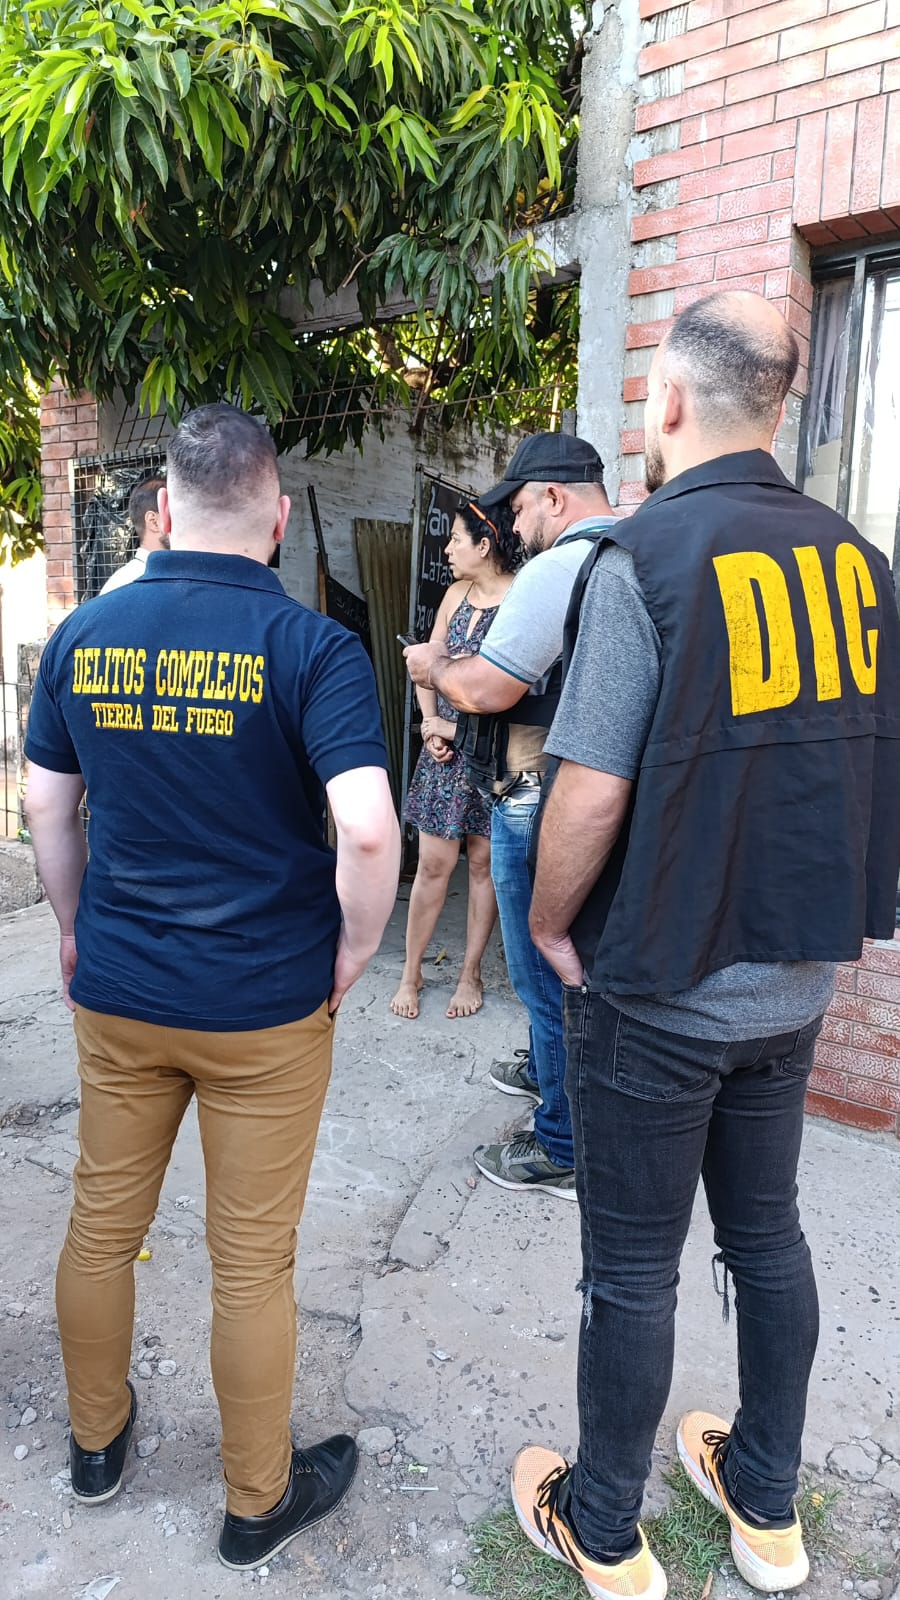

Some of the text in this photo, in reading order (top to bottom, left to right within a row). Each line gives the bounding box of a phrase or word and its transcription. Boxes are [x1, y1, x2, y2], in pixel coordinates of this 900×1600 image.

[713, 542, 878, 716] DIC
[74, 649, 264, 703] DELITOS COMPLEJOS
[92, 703, 233, 736] TIERRA DEL FUEGO
